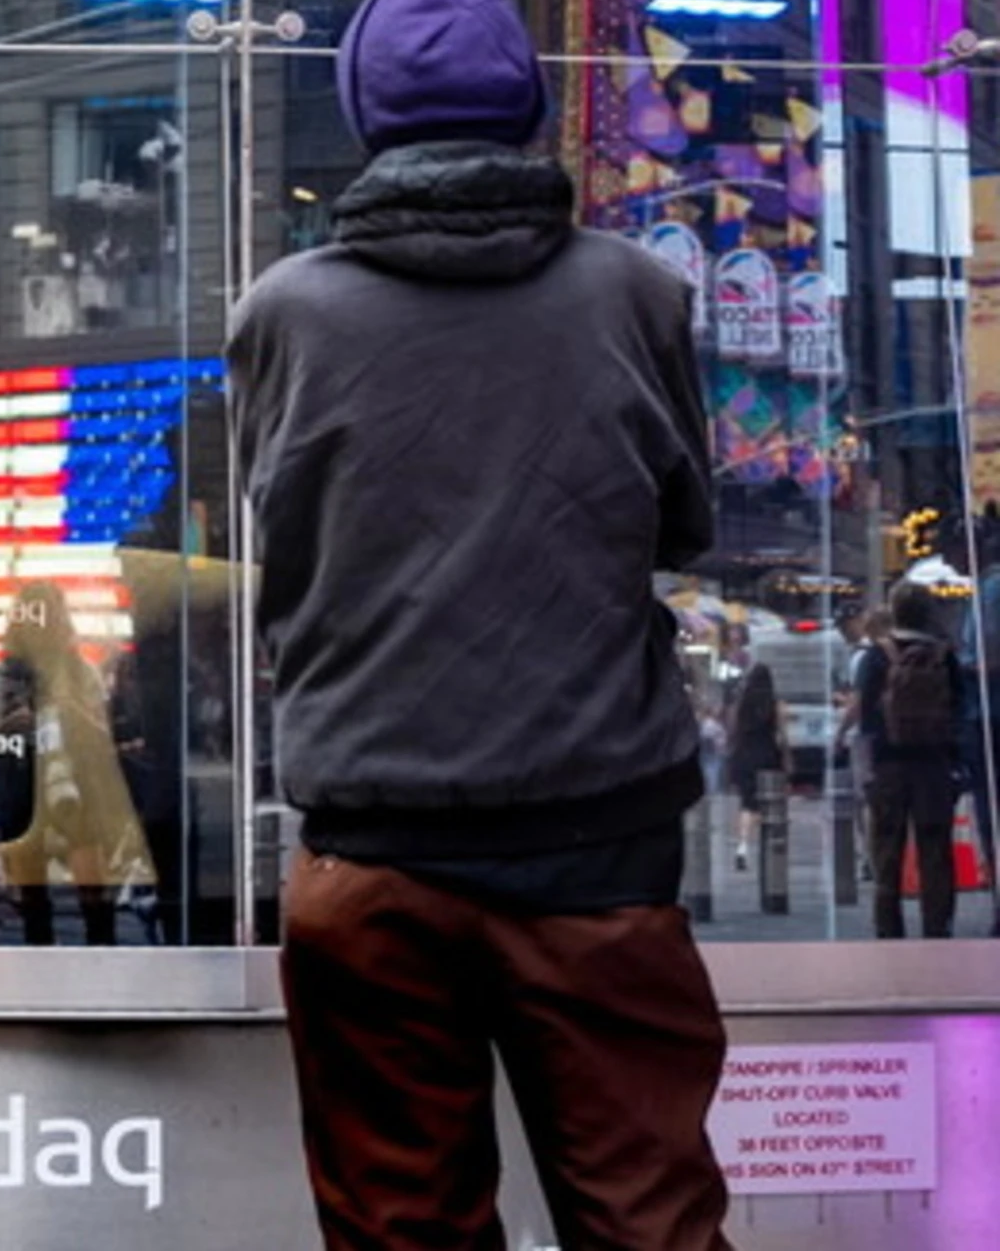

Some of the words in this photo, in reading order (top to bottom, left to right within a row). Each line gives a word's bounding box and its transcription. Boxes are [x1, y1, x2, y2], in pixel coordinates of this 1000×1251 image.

[723, 1061, 801, 1076] TANDPIPE
[818, 1057, 907, 1075] SPRINKLER
[721, 1086, 798, 1101] SHUT-OFF
[853, 1083, 901, 1099] VALVE
[773, 1110, 850, 1127] LOCATED
[760, 1136, 798, 1152] FEET
[803, 1134, 884, 1151] OPPOSITE
[749, 1161, 788, 1178] SIGN
[792, 1161, 816, 1175] ON
[853, 1157, 916, 1175] STREET
